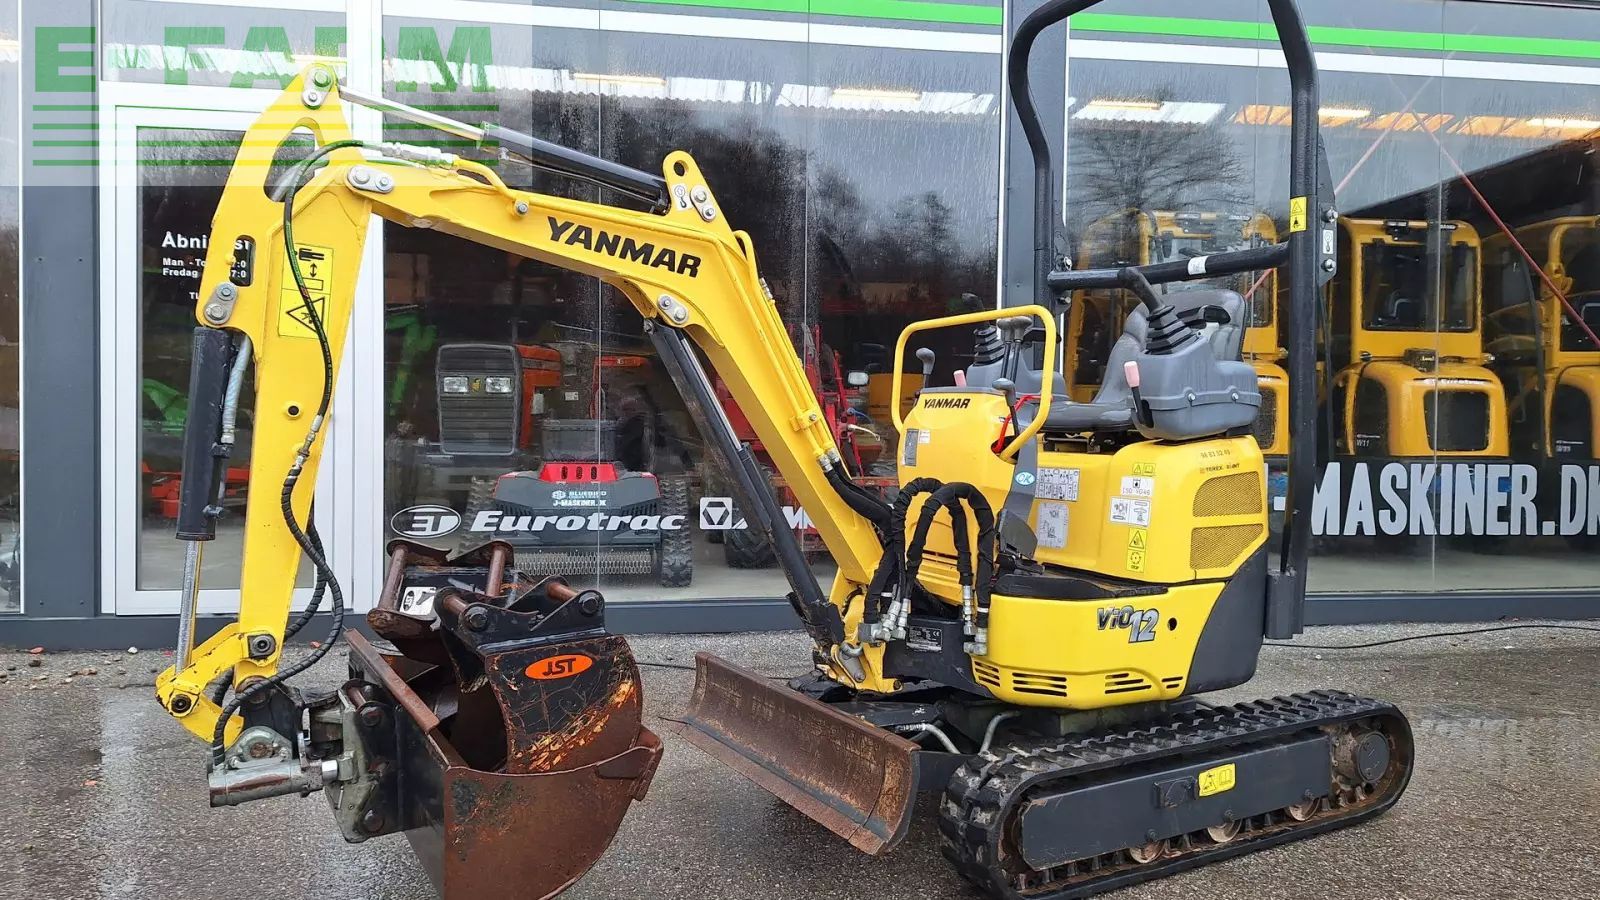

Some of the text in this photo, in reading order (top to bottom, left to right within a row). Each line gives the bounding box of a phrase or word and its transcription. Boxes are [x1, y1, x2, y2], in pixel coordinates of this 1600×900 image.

[547, 216, 701, 278] YANMAR
[162, 258, 184, 267] Man
[195, 259, 206, 267] To
[162, 267, 199, 278] Fredag
[923, 398, 971, 409] YANMAR
[1263, 462, 1600, 536] -MASKINER.D
[470, 510, 687, 532] Eurotrac
[542, 657, 577, 676] JST
